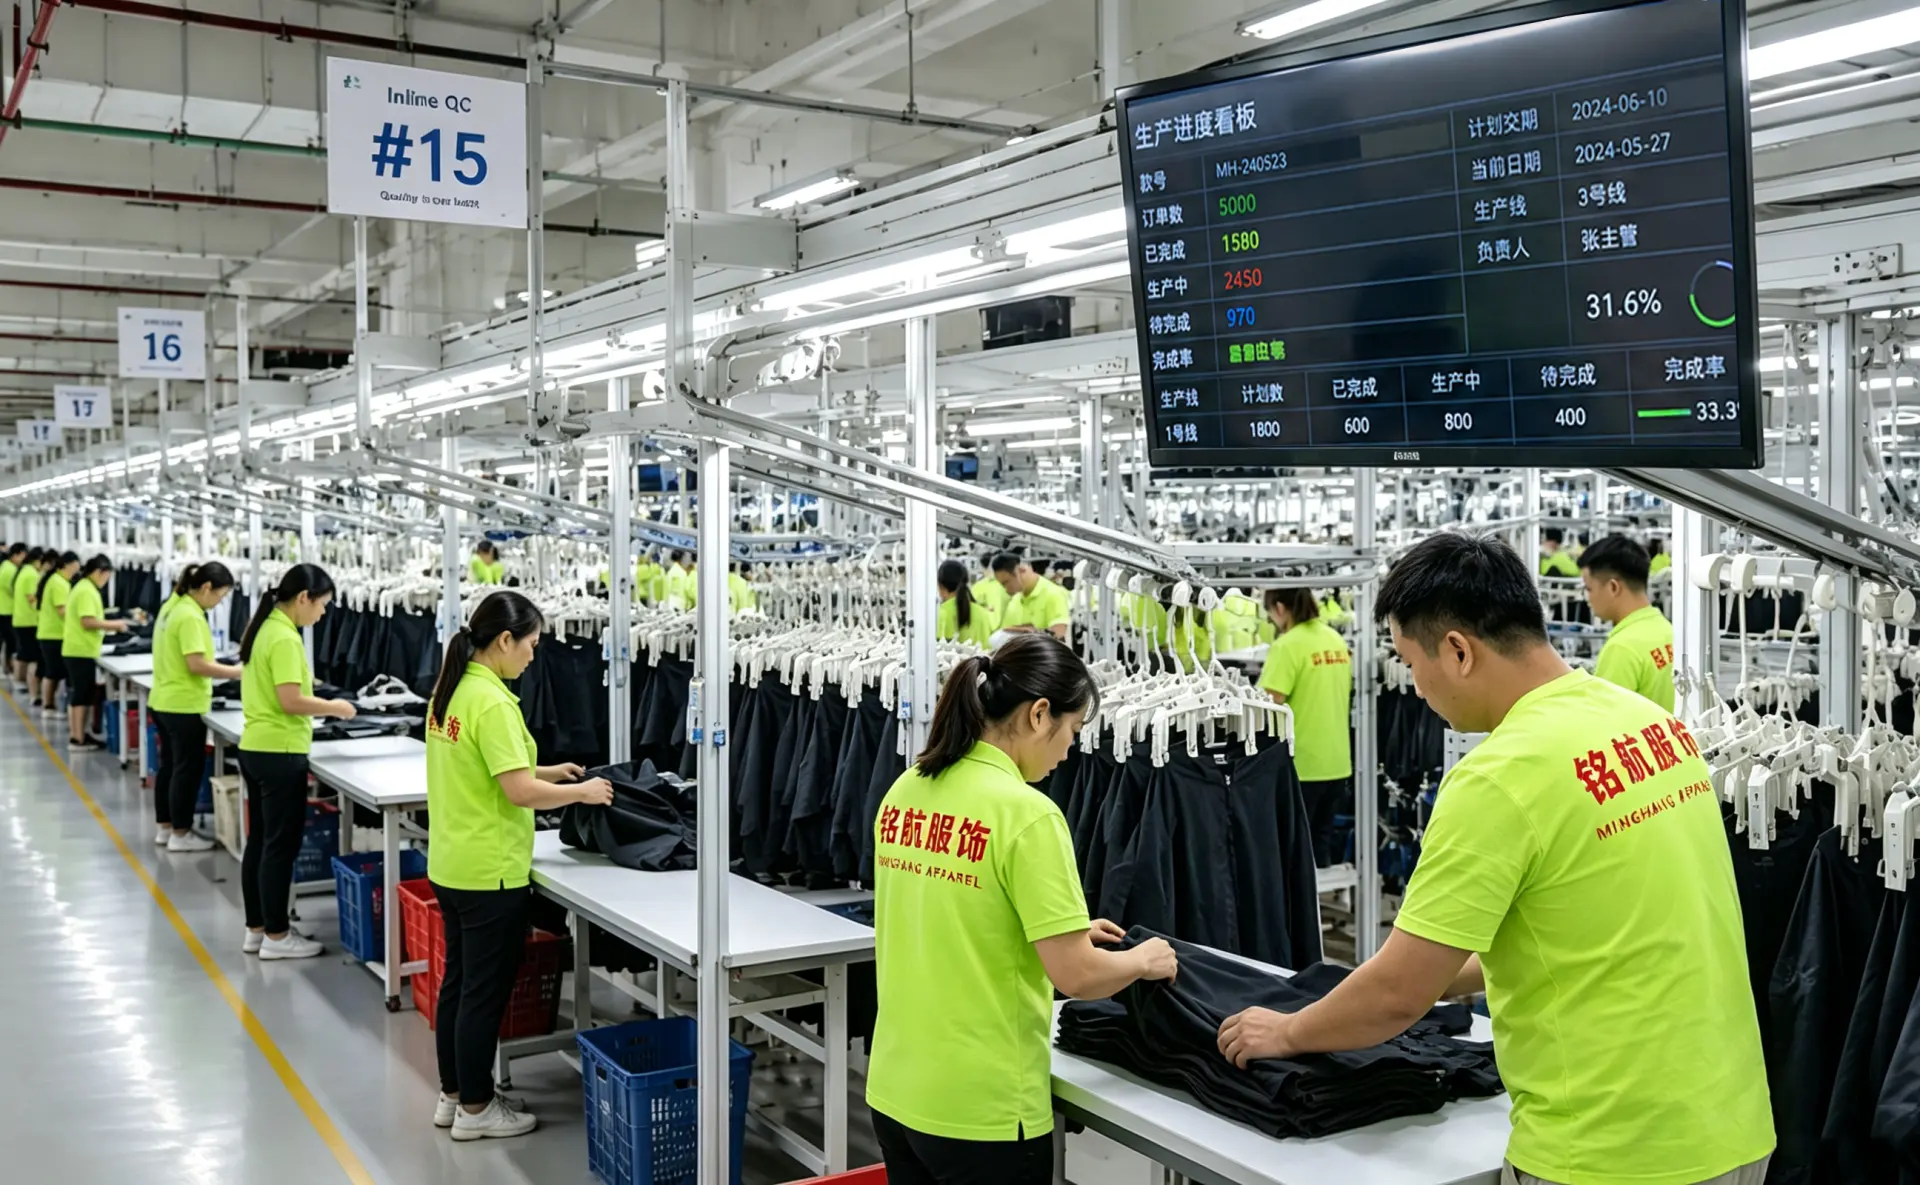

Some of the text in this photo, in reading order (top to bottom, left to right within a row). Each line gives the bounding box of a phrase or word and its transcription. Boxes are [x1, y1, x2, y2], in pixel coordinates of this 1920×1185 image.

[445, 95, 472, 113] QC
[1468, 87, 1668, 139] 计划交期 2024-06-10
[1134, 100, 1257, 150] 生产进度看板
[371, 122, 488, 186] #15
[1575, 132, 1671, 164] 2024-05-27
[1219, 193, 1257, 216] 5000
[1474, 180, 1627, 222] 生产线 3号线
[1145, 230, 1259, 264] 已完成 1580
[1580, 223, 1639, 252] 张主管
[1147, 267, 1262, 299] 生产中 2450
[1586, 288, 1662, 319] 31.6%
[1149, 306, 1256, 335] 待完成 970
[143, 332, 182, 362] 16
[1152, 348, 1193, 371] 完成率
[1332, 376, 1378, 399] 已完成
[1431, 370, 1480, 393] 生产中
[1540, 363, 1597, 388] 待完成
[1664, 355, 1726, 382] 完成率
[1250, 421, 1281, 437] 1800
[1344, 416, 1370, 435] 600
[1444, 412, 1473, 431] 800
[1555, 407, 1587, 426] 400
[1696, 401, 1740, 421] 33.3
